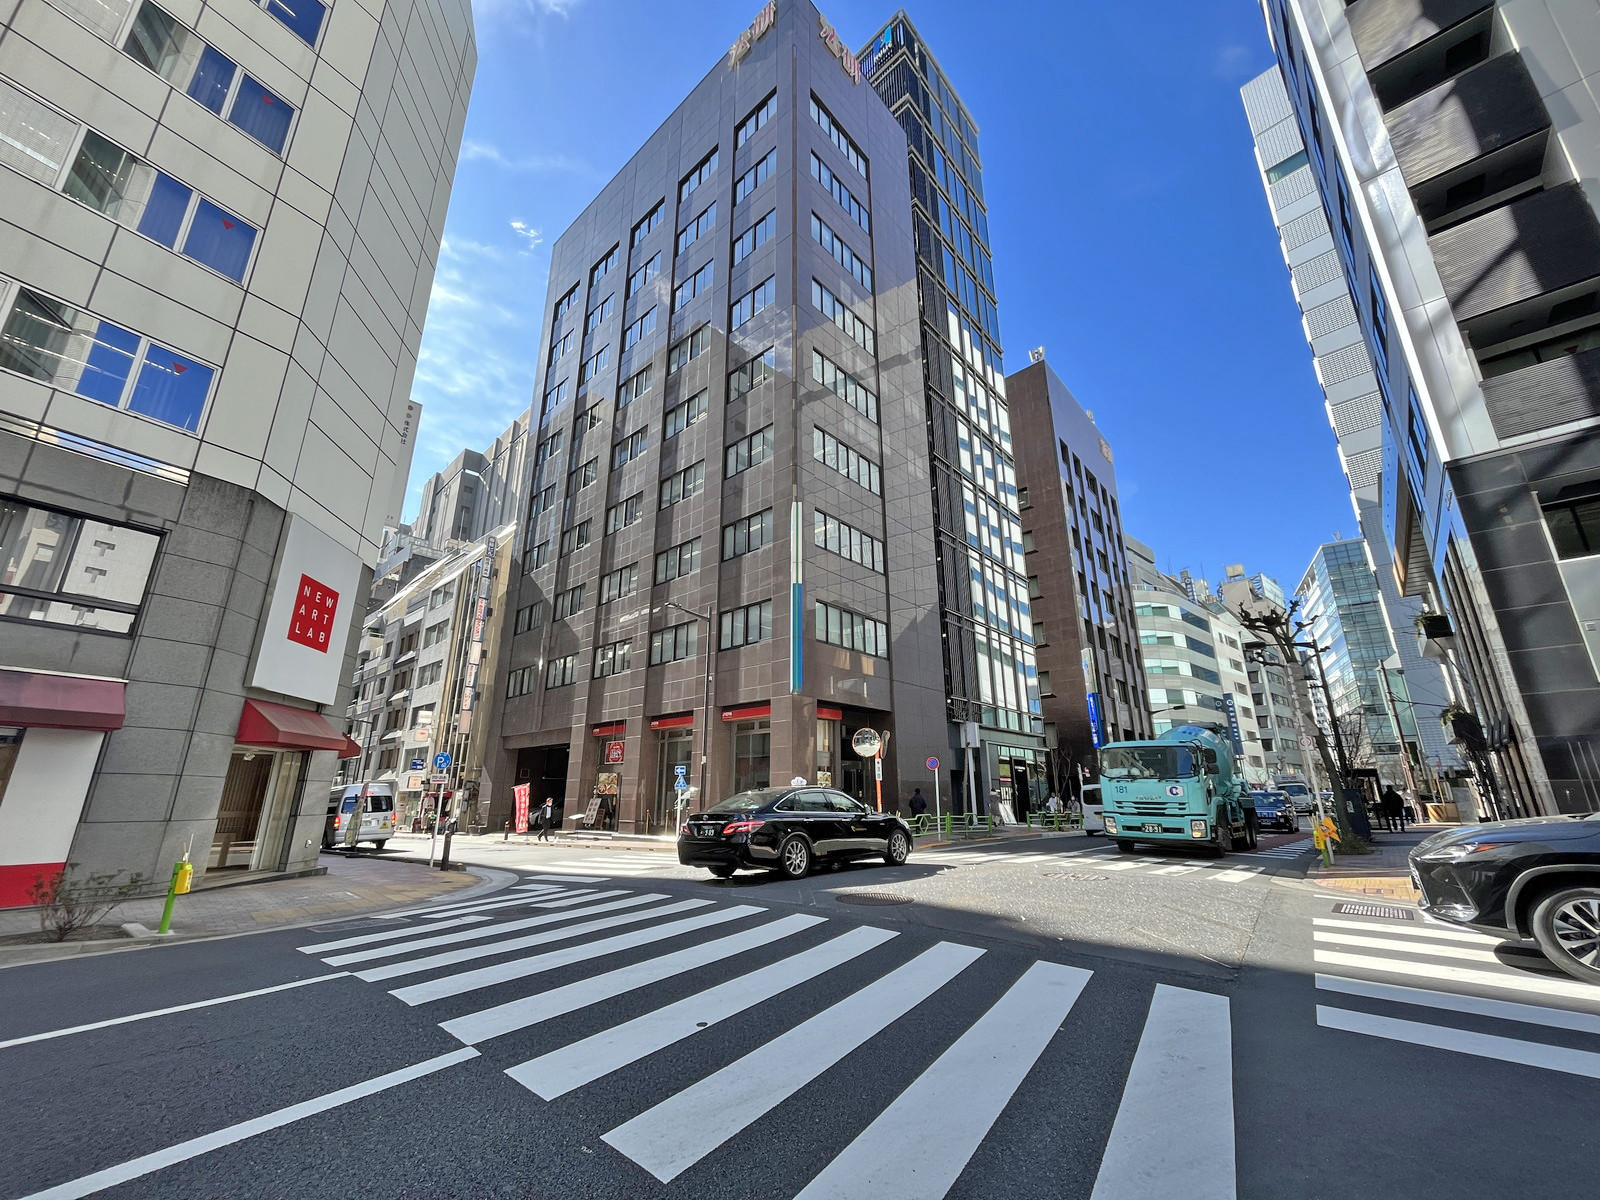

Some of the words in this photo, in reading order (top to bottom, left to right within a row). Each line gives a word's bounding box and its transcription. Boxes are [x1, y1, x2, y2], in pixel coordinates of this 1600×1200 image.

[303, 585, 334, 609] NEW
[299, 604, 329, 625] ART
[295, 622, 326, 643] LAB
[436, 756, 445, 768] P
[1115, 786, 1128, 794] 181
[1169, 786, 1179, 796] C
